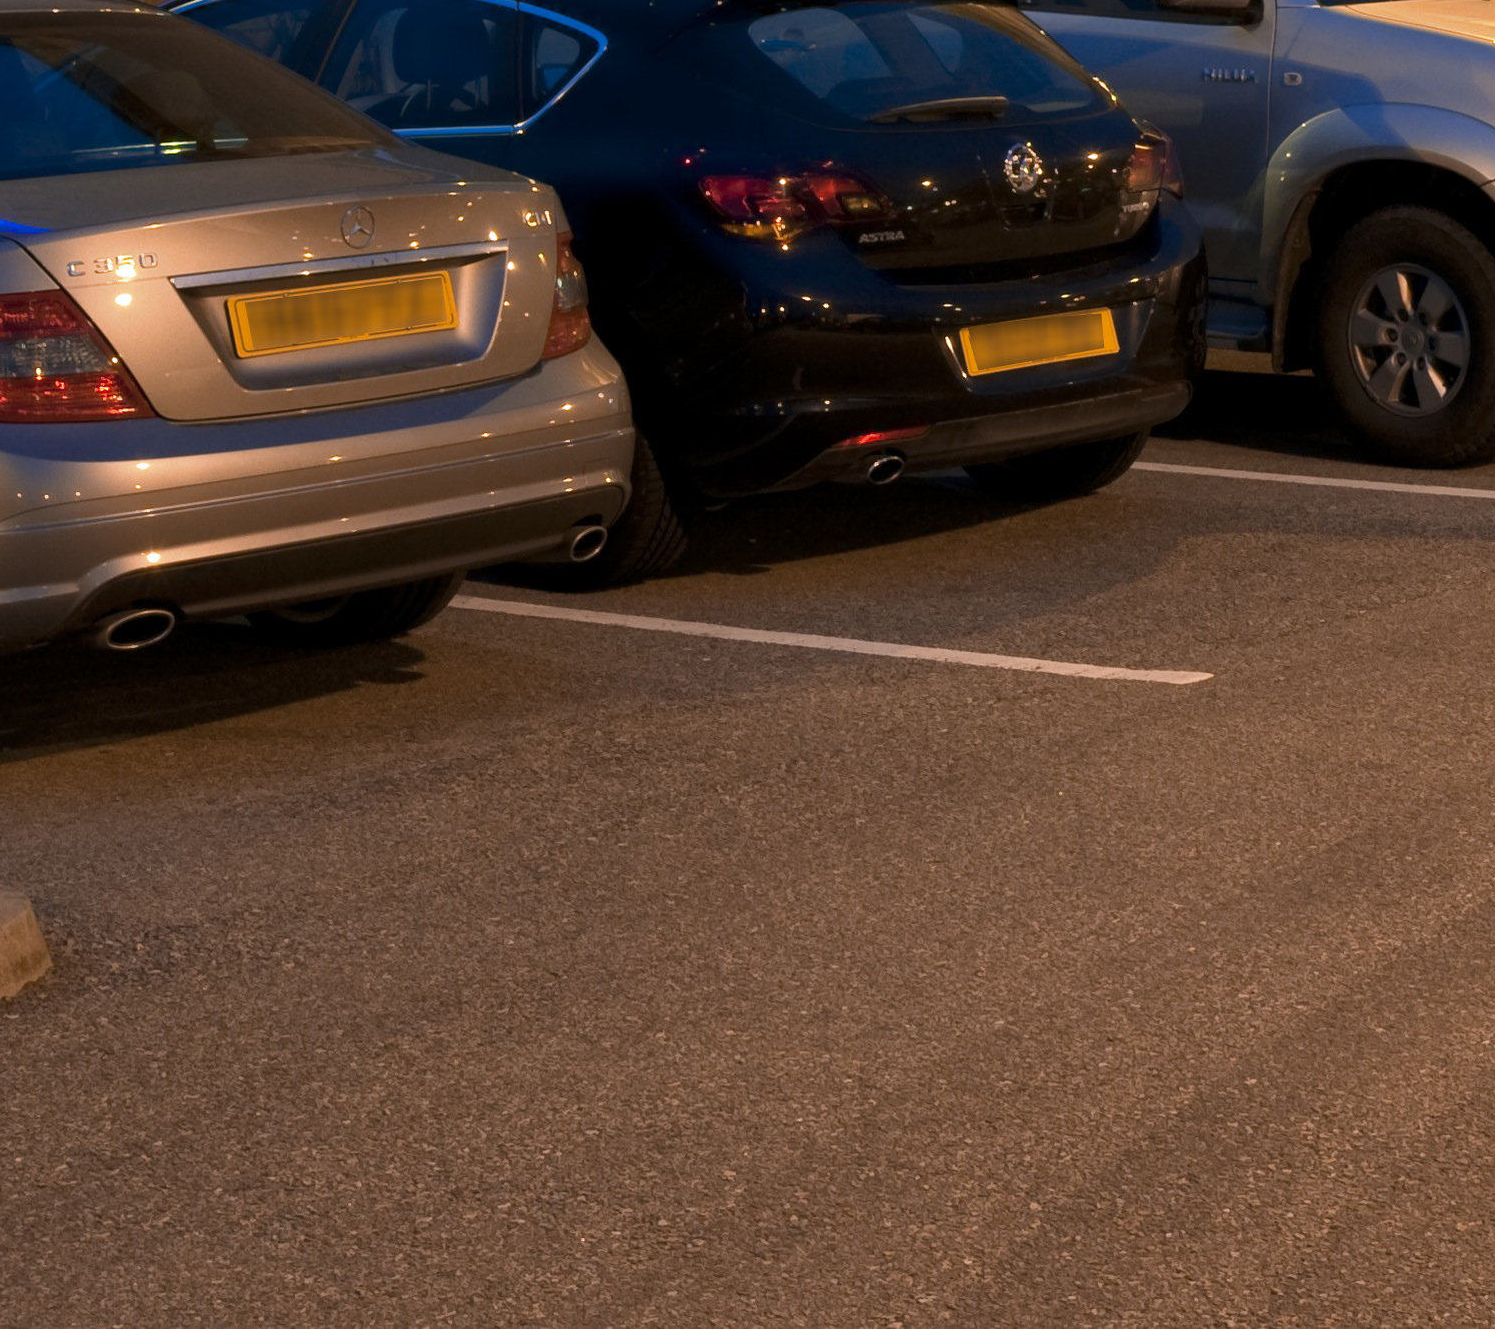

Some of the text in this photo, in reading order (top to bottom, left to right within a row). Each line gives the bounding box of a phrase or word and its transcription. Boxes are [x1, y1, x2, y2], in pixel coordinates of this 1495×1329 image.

[858, 230, 906, 243] ASTRA
[67, 252, 159, 277] C 350
